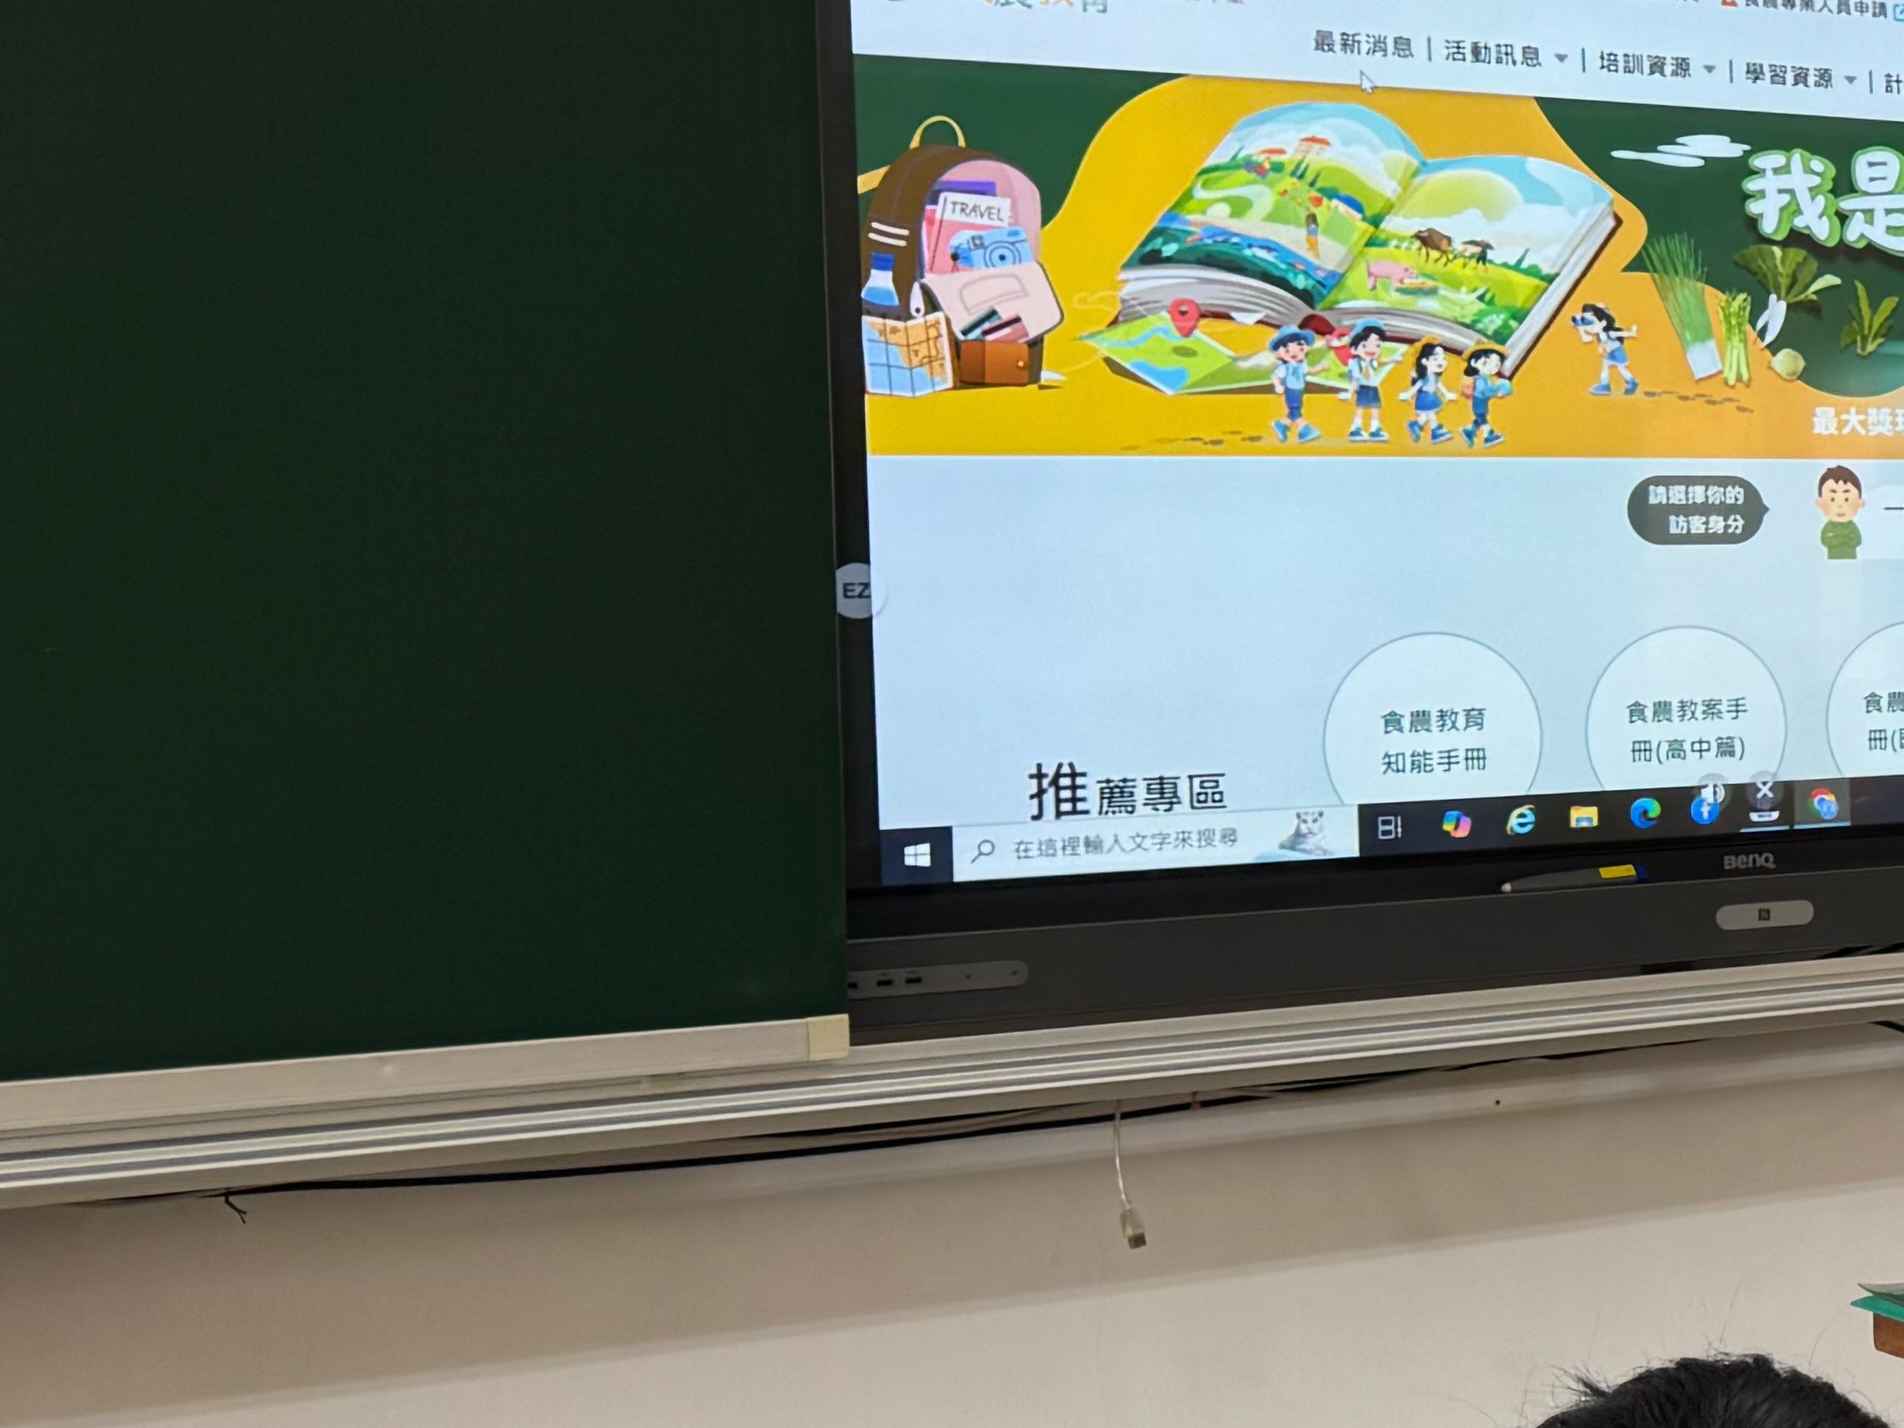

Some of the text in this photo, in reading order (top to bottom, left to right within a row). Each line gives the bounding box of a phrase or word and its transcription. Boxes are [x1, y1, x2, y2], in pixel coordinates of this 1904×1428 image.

[1312, 29, 1415, 59] 最新消息
[1444, 38, 1543, 68] 活動訊息
[1600, 50, 1692, 79] 培訓資源
[1744, 61, 1835, 90] 學習資源
[949, 200, 1005, 222] TRAVEL
[1648, 484, 1745, 506] 請選擇你的
[1668, 514, 1746, 536] 訪客身分
[1380, 706, 1488, 736] 食農教育
[1625, 696, 1750, 725] 食農教案手
[1381, 746, 1488, 776] 知能手冊
[1630, 735, 1747, 765] 冊(高中篇)
[1027, 760, 1229, 823] 推薦專區
[1013, 826, 1240, 862] 在這裡輸入文字來搜尋
[1723, 851, 1777, 871] BenQ
